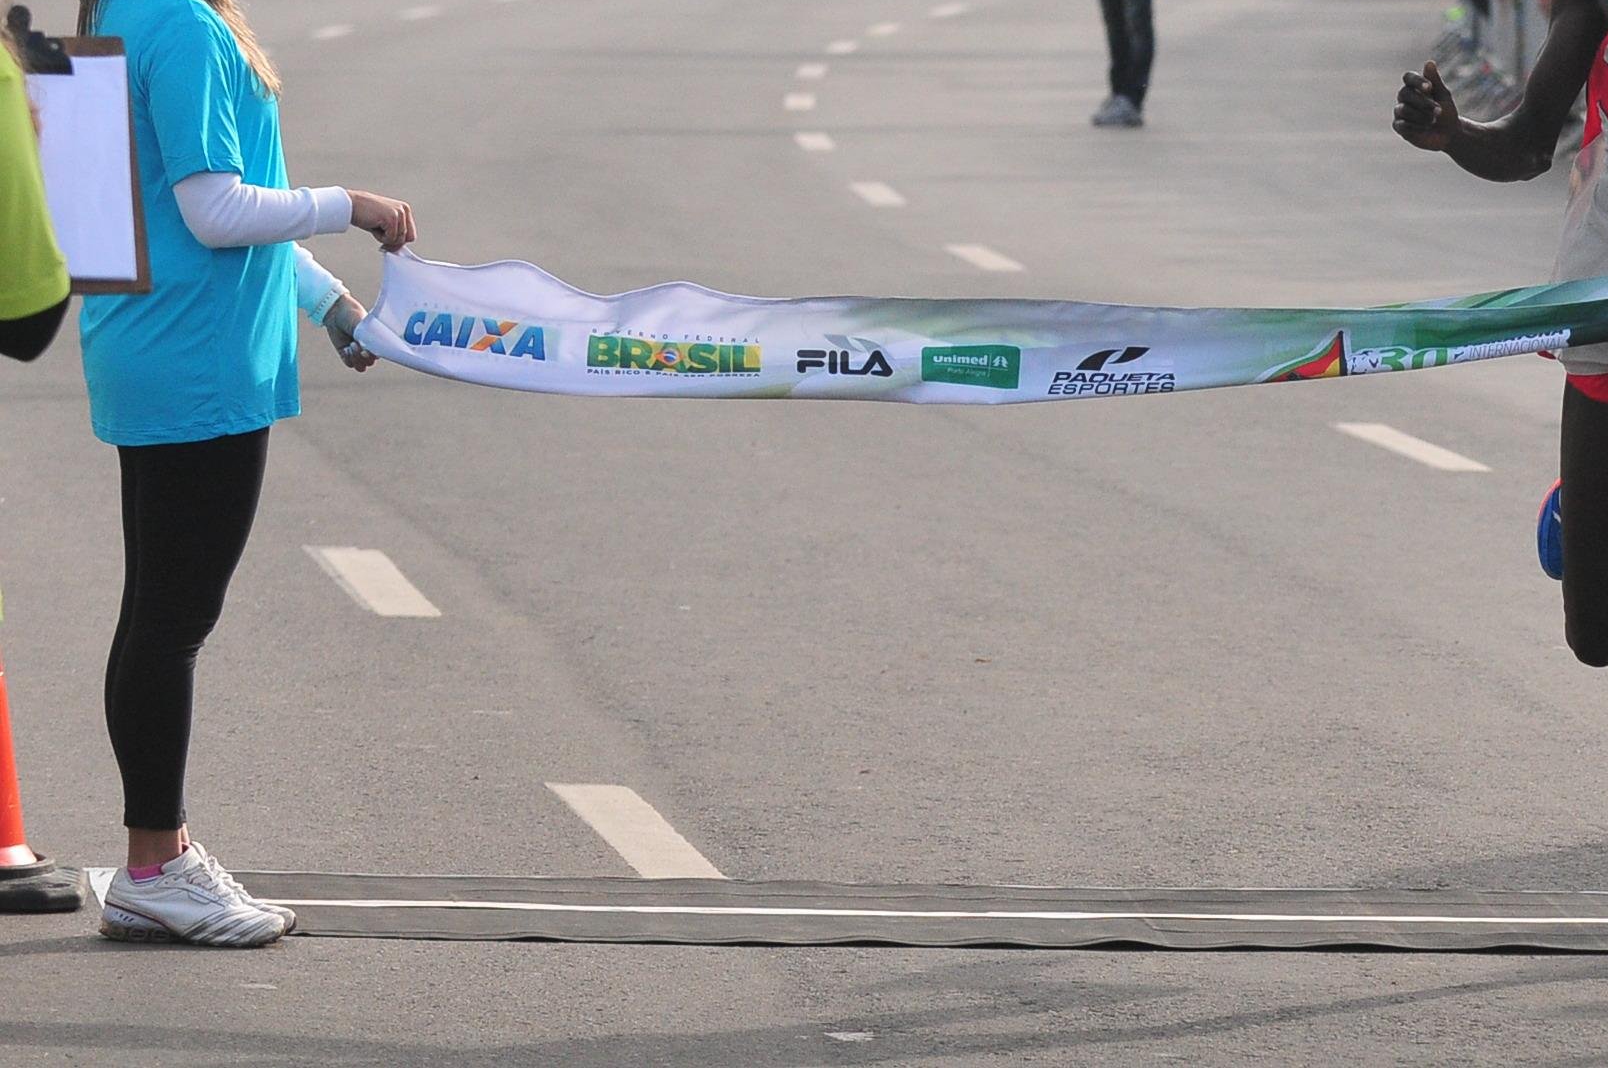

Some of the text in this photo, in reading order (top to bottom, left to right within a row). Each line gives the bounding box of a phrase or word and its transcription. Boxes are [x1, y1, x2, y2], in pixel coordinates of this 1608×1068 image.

[404, 311, 546, 361] CAIXA
[587, 335, 761, 373] BRASIL
[796, 350, 894, 377] FILA
[933, 354, 988, 366] Unimed
[1048, 381, 1175, 395] ESPORTES
